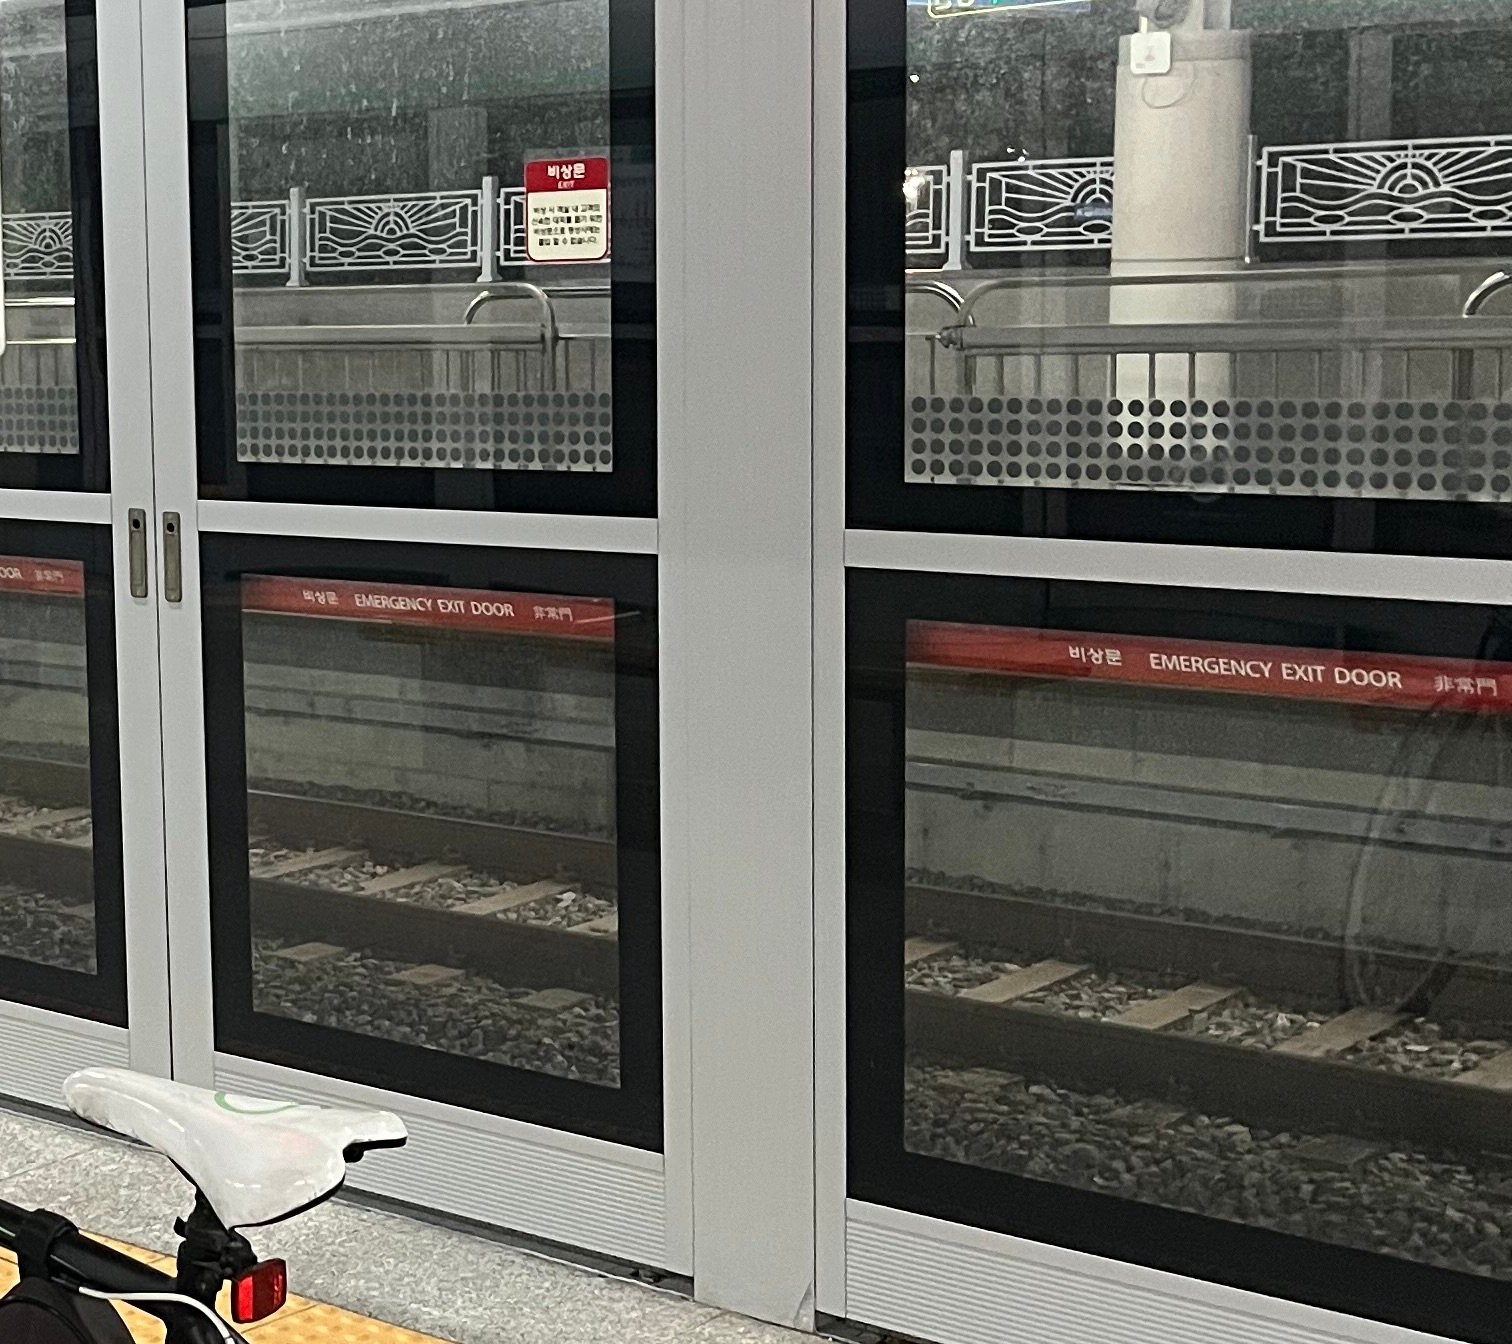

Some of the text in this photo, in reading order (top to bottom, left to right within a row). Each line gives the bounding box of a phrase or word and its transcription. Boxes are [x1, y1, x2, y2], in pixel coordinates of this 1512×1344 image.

[547, 163, 585, 179] 비상문
[354, 593, 515, 618] EMERGENCY EXIT DOOR
[1068, 644, 1123, 668] 비상문
[1149, 652, 1404, 691] EMERGENCY EXIT DOOR
[1433, 674, 1499, 698] 非常門
